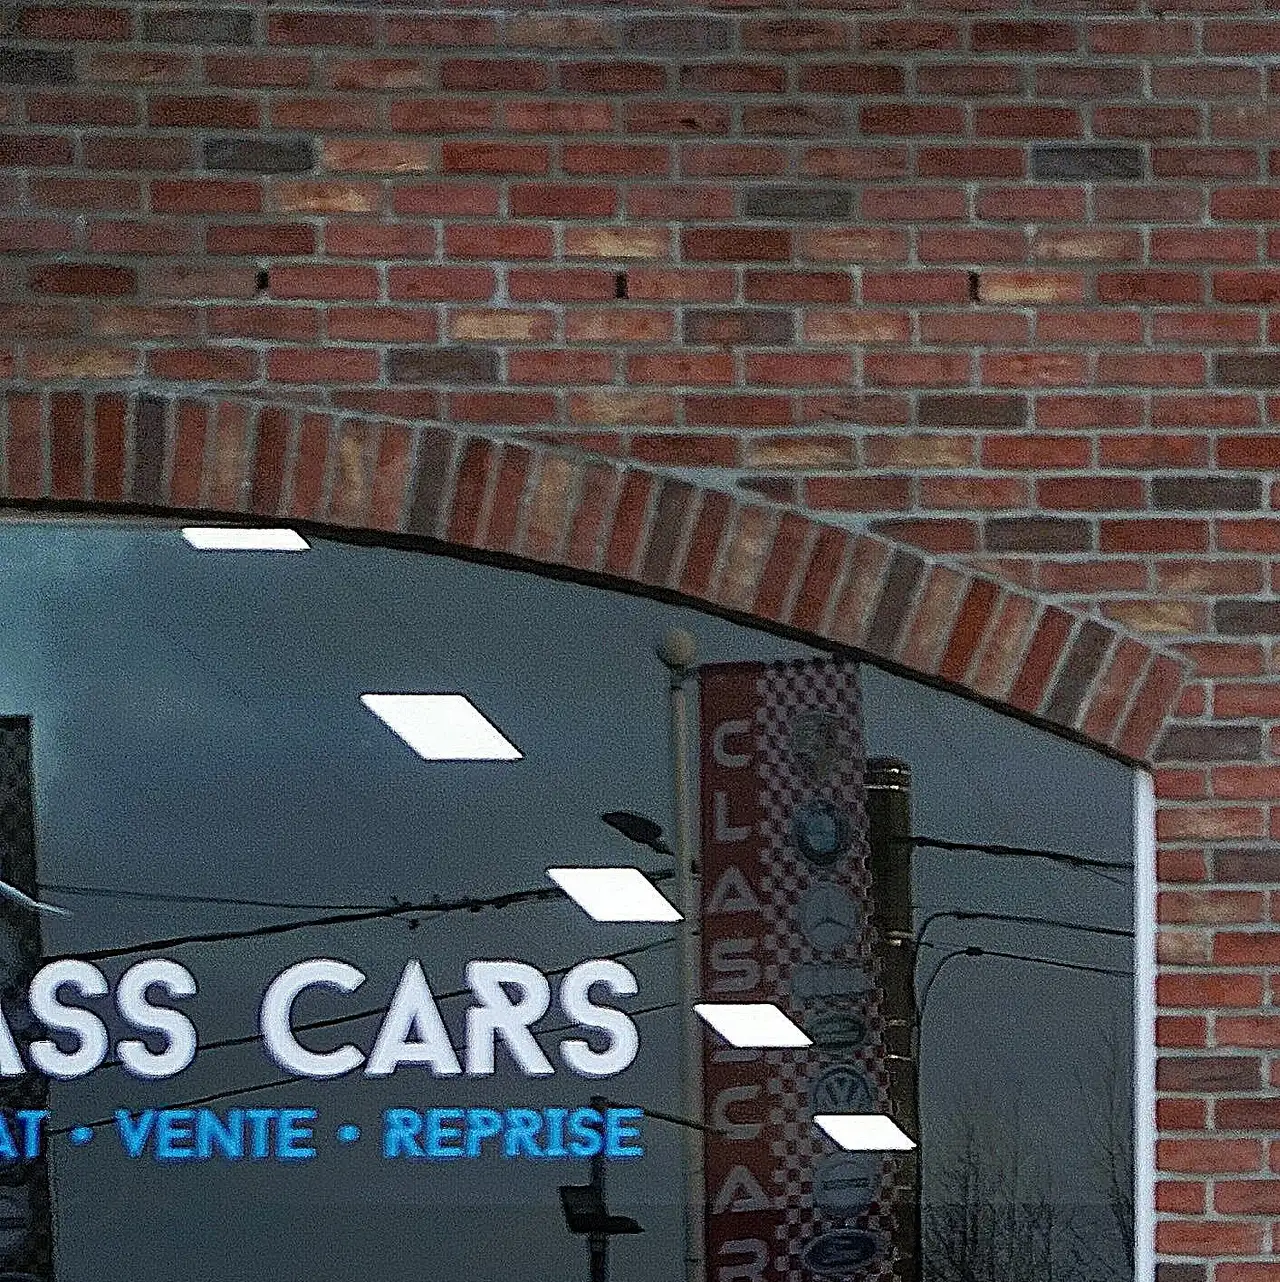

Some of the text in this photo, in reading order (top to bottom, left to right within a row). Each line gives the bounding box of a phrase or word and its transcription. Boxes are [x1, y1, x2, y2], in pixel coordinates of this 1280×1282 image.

[708, 717, 763, 1063] CLAS
[0, 958, 640, 1078] SS CARS
[115, 1108, 318, 1162] VENTE
[382, 1107, 645, 1162] REPRISE
